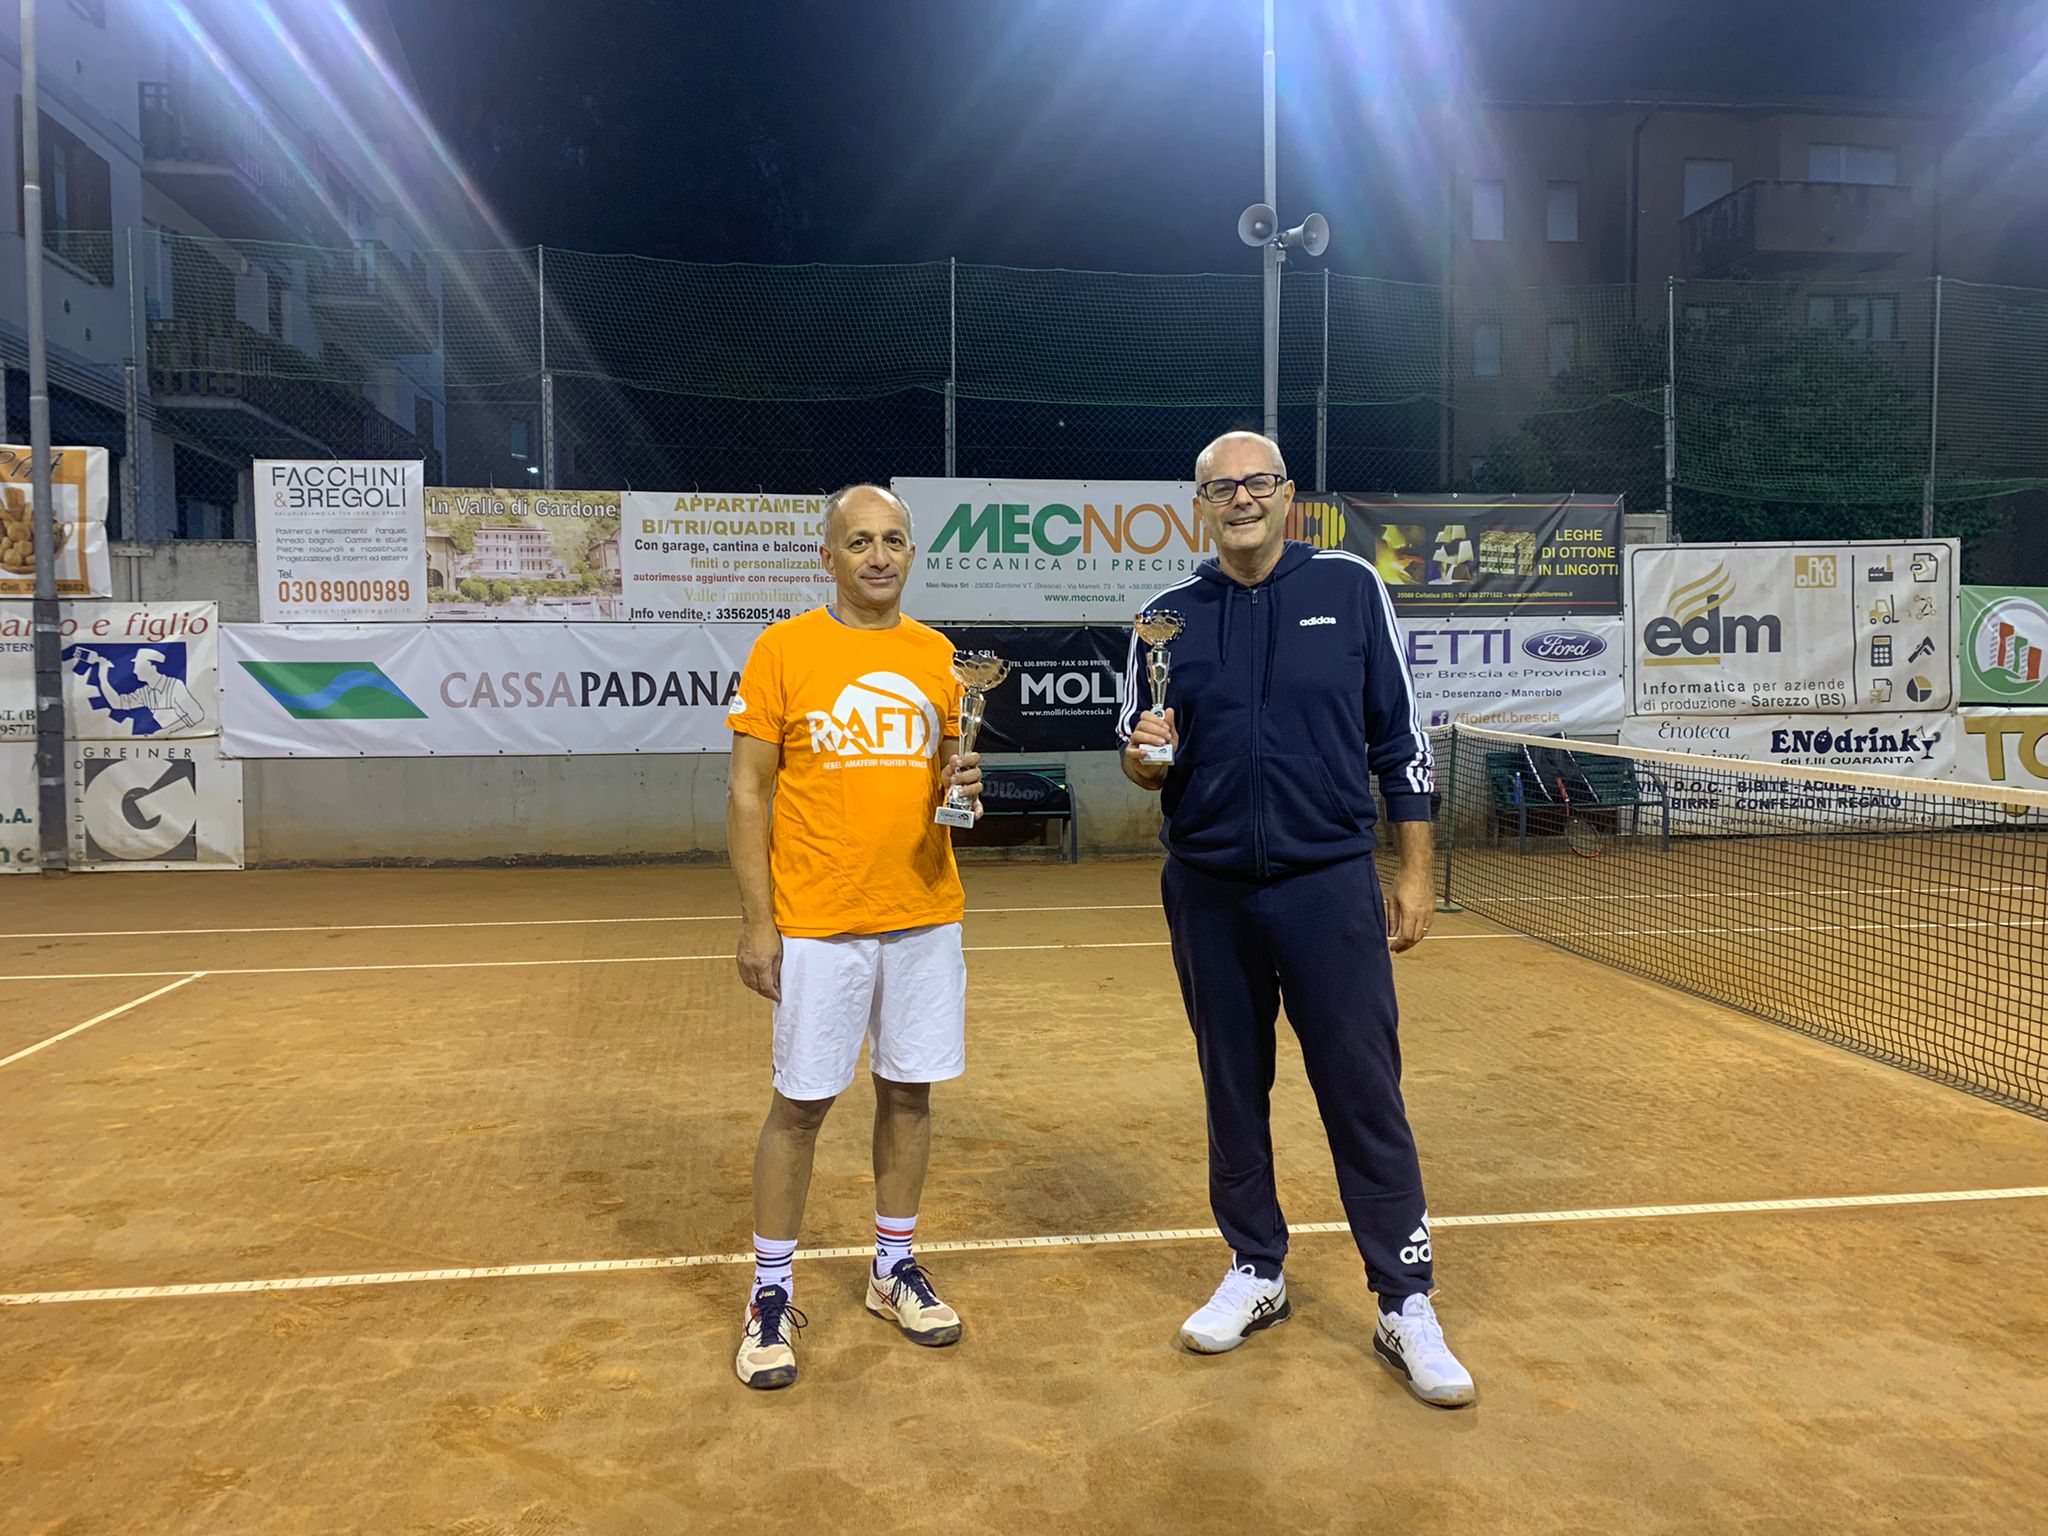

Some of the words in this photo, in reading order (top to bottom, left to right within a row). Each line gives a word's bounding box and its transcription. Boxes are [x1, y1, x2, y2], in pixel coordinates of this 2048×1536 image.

[272, 467, 406, 486] FACCHINI
[430, 496, 449, 514] In
[456, 496, 504, 515] Valle
[511, 498, 529, 516] di
[534, 498, 617, 517] Gardone
[642, 519, 796, 536] BI/TRI/QUADRI
[928, 503, 1210, 556] MECNOV
[1555, 529, 1603, 542] LEGHE
[634, 539, 658, 551] Con
[662, 541, 710, 554] garage,
[712, 541, 758, 552] cantina
[762, 543, 770, 552] e
[774, 541, 818, 552] balconi
[1542, 546, 1556, 560] DI
[1559, 546, 1616, 560] OTTONE
[690, 558, 718, 568] finiti
[722, 560, 730, 569] o
[927, 558, 1062, 570] MECCANICA
[1077, 559, 1096, 570] DI
[1538, 564, 1552, 576] IN
[1556, 564, 1619, 576] LINGOTTI
[278, 569, 294, 578] Tel.
[633, 572, 693, 582] autorimesse
[696, 573, 745, 584] aggiuntive
[768, 575, 810, 584] recupero
[684, 588, 717, 602] Valle
[1044, 594, 1125, 602] www.mecnova.it
[630, 608, 654, 620] Info
[658, 608, 704, 620] vendite
[716, 608, 791, 620] 3356205148
[92, 618, 111, 636] e
[125, 612, 209, 642] figlio
[1300, 616, 1336, 626] adidas
[1644, 594, 1781, 656] edm
[1538, 634, 1590, 656] Ford
[1438, 670, 1503, 679] Brescia
[1524, 668, 1607, 678] Provincia
[1442, 690, 1502, 699] Desenzano
[1512, 688, 1562, 698] Manerbio
[1643, 680, 1746, 695] Informatica
[1753, 683, 1781, 693] per
[1784, 679, 1845, 692] aziende
[1644, 700, 1656, 712] di
[1661, 698, 1736, 712] produzione
[1751, 694, 1810, 708] Sarezzo
[1815, 692, 1846, 709] (BS)
[1658, 721, 1730, 740] Enoteca
[83, 747, 194, 758] GREINER
[845, 760, 878, 768] AMATEUR
[1782, 756, 1801, 765] dei
[1830, 756, 1914, 764] QUARANTA
